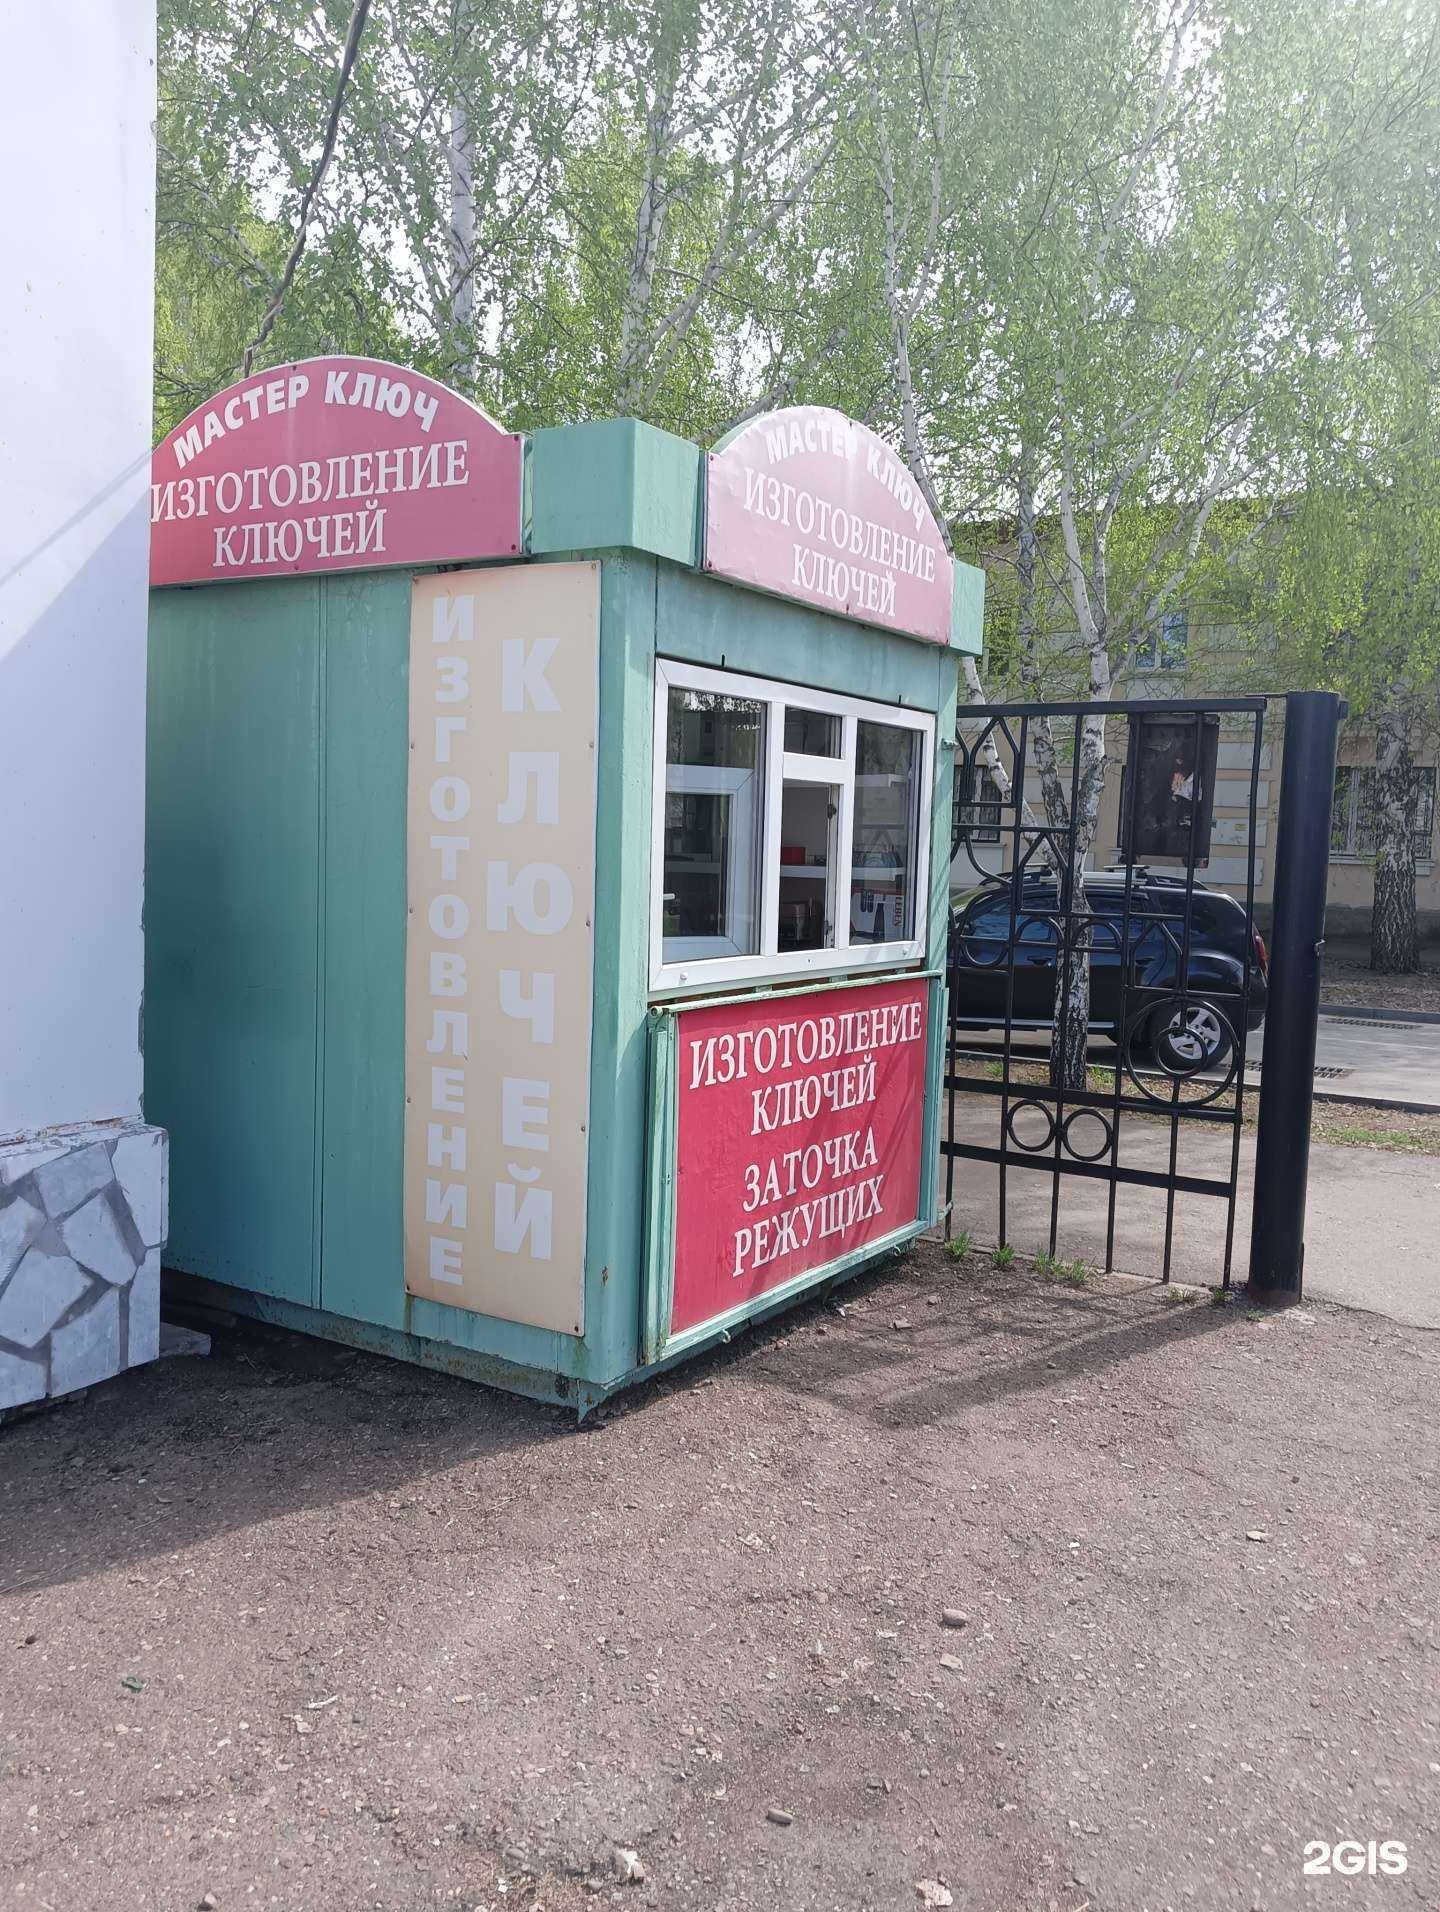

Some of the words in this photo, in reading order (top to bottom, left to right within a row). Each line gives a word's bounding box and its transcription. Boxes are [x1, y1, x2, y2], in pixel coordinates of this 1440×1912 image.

[172, 375, 310, 470] МАСТЕР
[323, 370, 440, 433] КЛЮЧ
[150, 439, 470, 523] ИЗГОТОВЛЕНИЕ
[744, 467, 936, 583] ИЗГОТОВЛЕНИЕ
[867, 444, 925, 532] КЛЮЧ
[212, 499, 387, 567] КЛЮЧЕЙ
[791, 543, 897, 617] КЛЮЧЕЙ
[426, 595, 474, 1286] ИЗГОТОВЛЕНИЕ
[486, 637, 574, 1261] КЛЮЧЕЙ
[688, 1001, 923, 1090] ИЗГОТОВЛЕНИЕ
[750, 1053, 877, 1136] КЛЮЧЕЙ
[743, 1125, 878, 1213] ЗАТОЧКА
[731, 1174, 884, 1278] РЕЖУЩИХ
